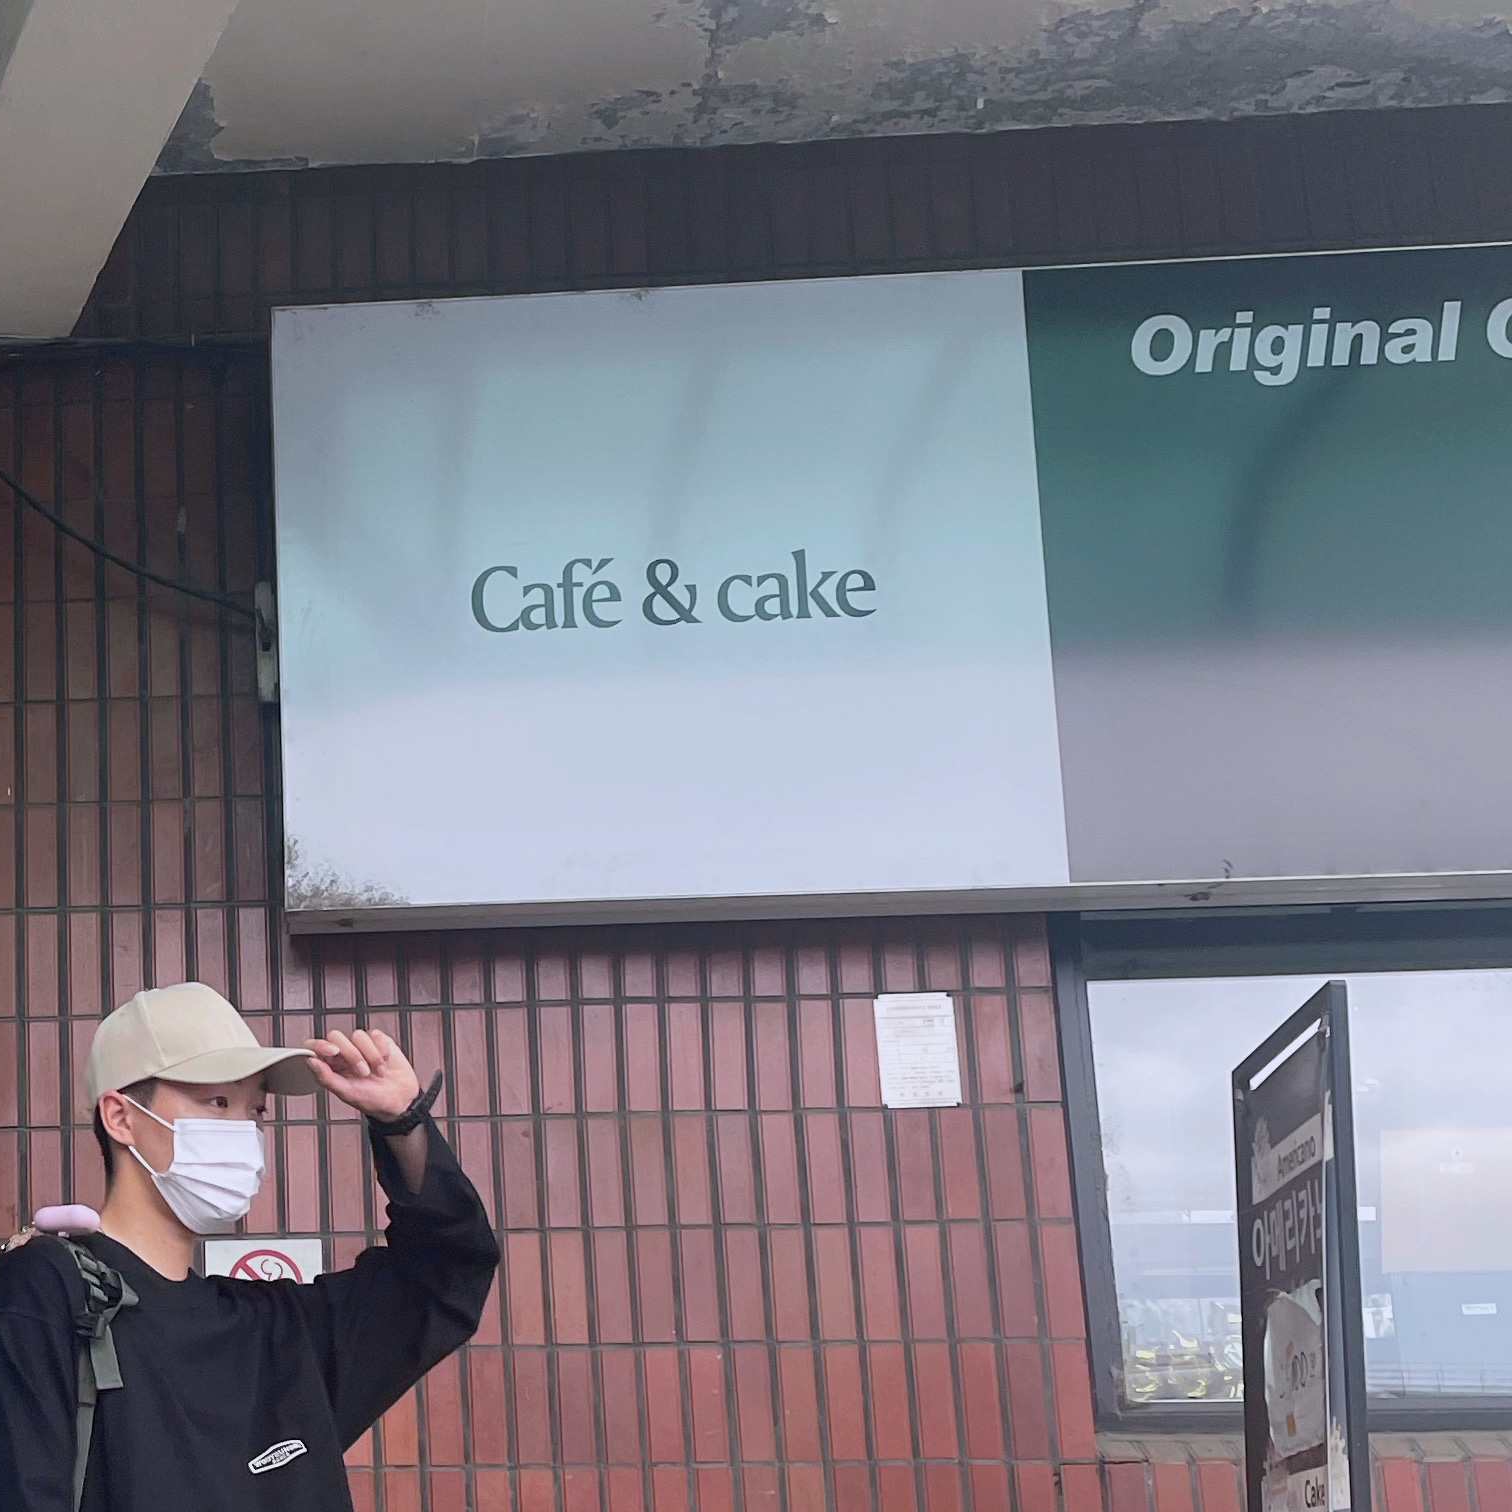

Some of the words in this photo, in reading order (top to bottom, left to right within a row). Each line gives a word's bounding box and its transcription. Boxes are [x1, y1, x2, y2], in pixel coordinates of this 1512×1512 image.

[1131, 300, 1462, 387] Original
[470, 558, 622, 633] Café
[641, 557, 702, 627] &
[715, 548, 877, 622] cake
